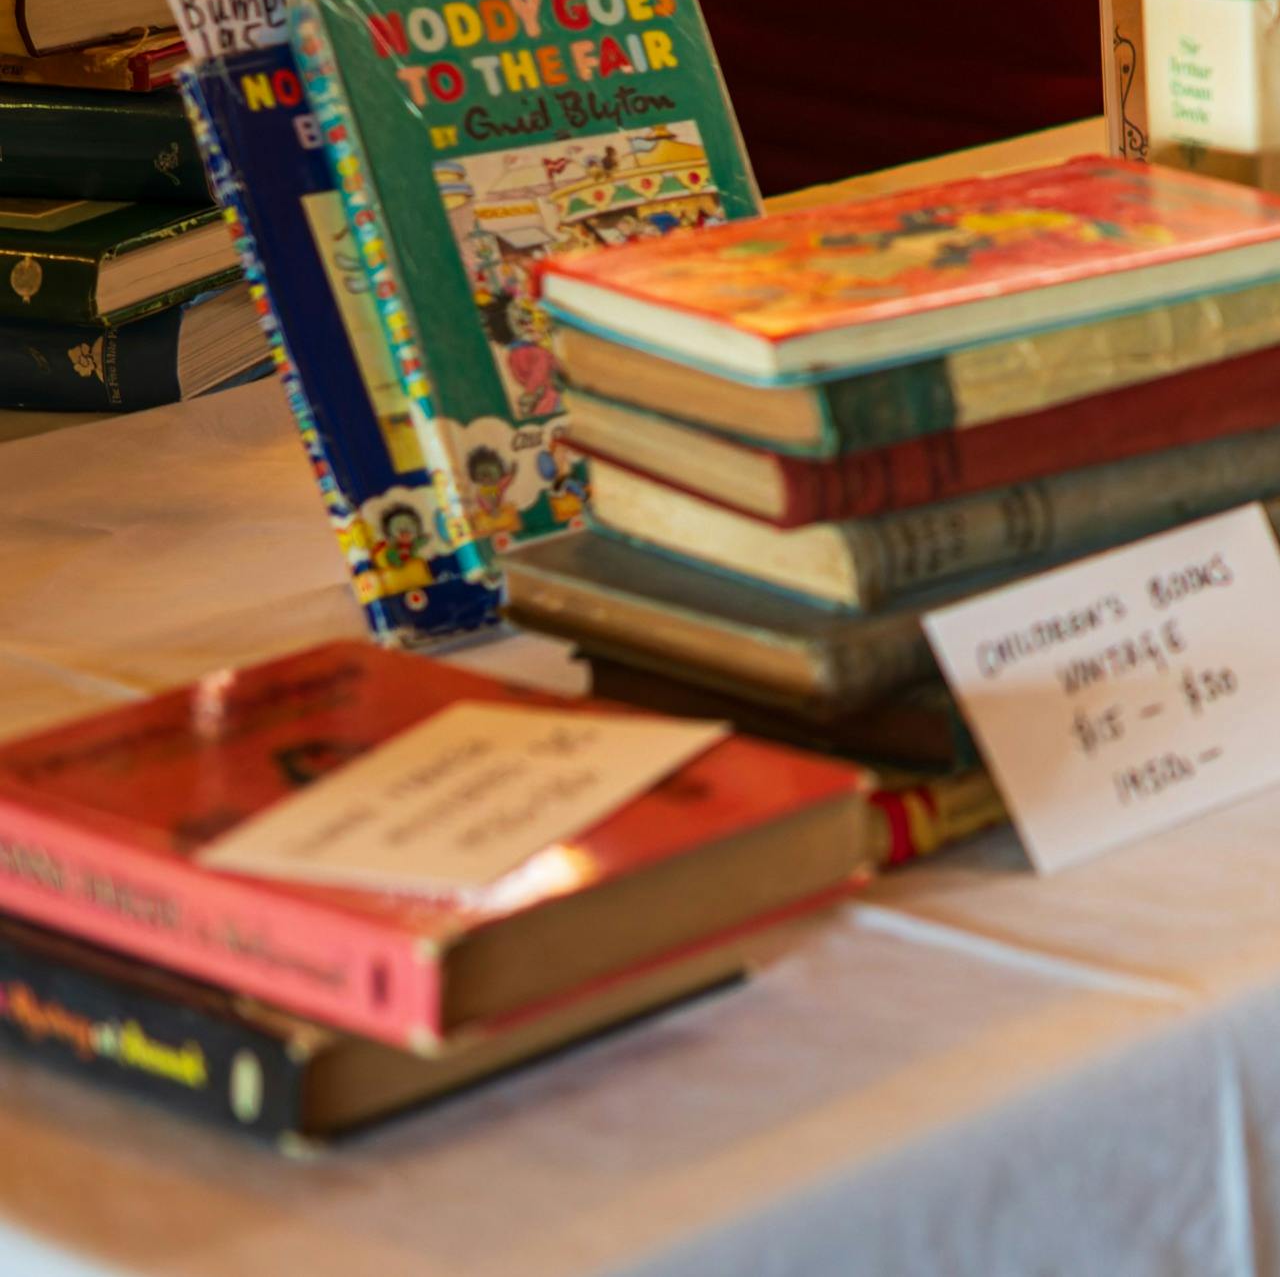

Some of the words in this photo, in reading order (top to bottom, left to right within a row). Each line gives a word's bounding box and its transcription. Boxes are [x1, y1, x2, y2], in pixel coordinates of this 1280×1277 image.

[397, 62, 465, 108] TO
[470, 46, 569, 96] THE
[570, 30, 678, 82] FAIR
[429, 126, 461, 151] BY
[463, 99, 548, 141] Enid
[561, 88, 677, 129] Blyton
[1146, 552, 1235, 611] BOOKS
